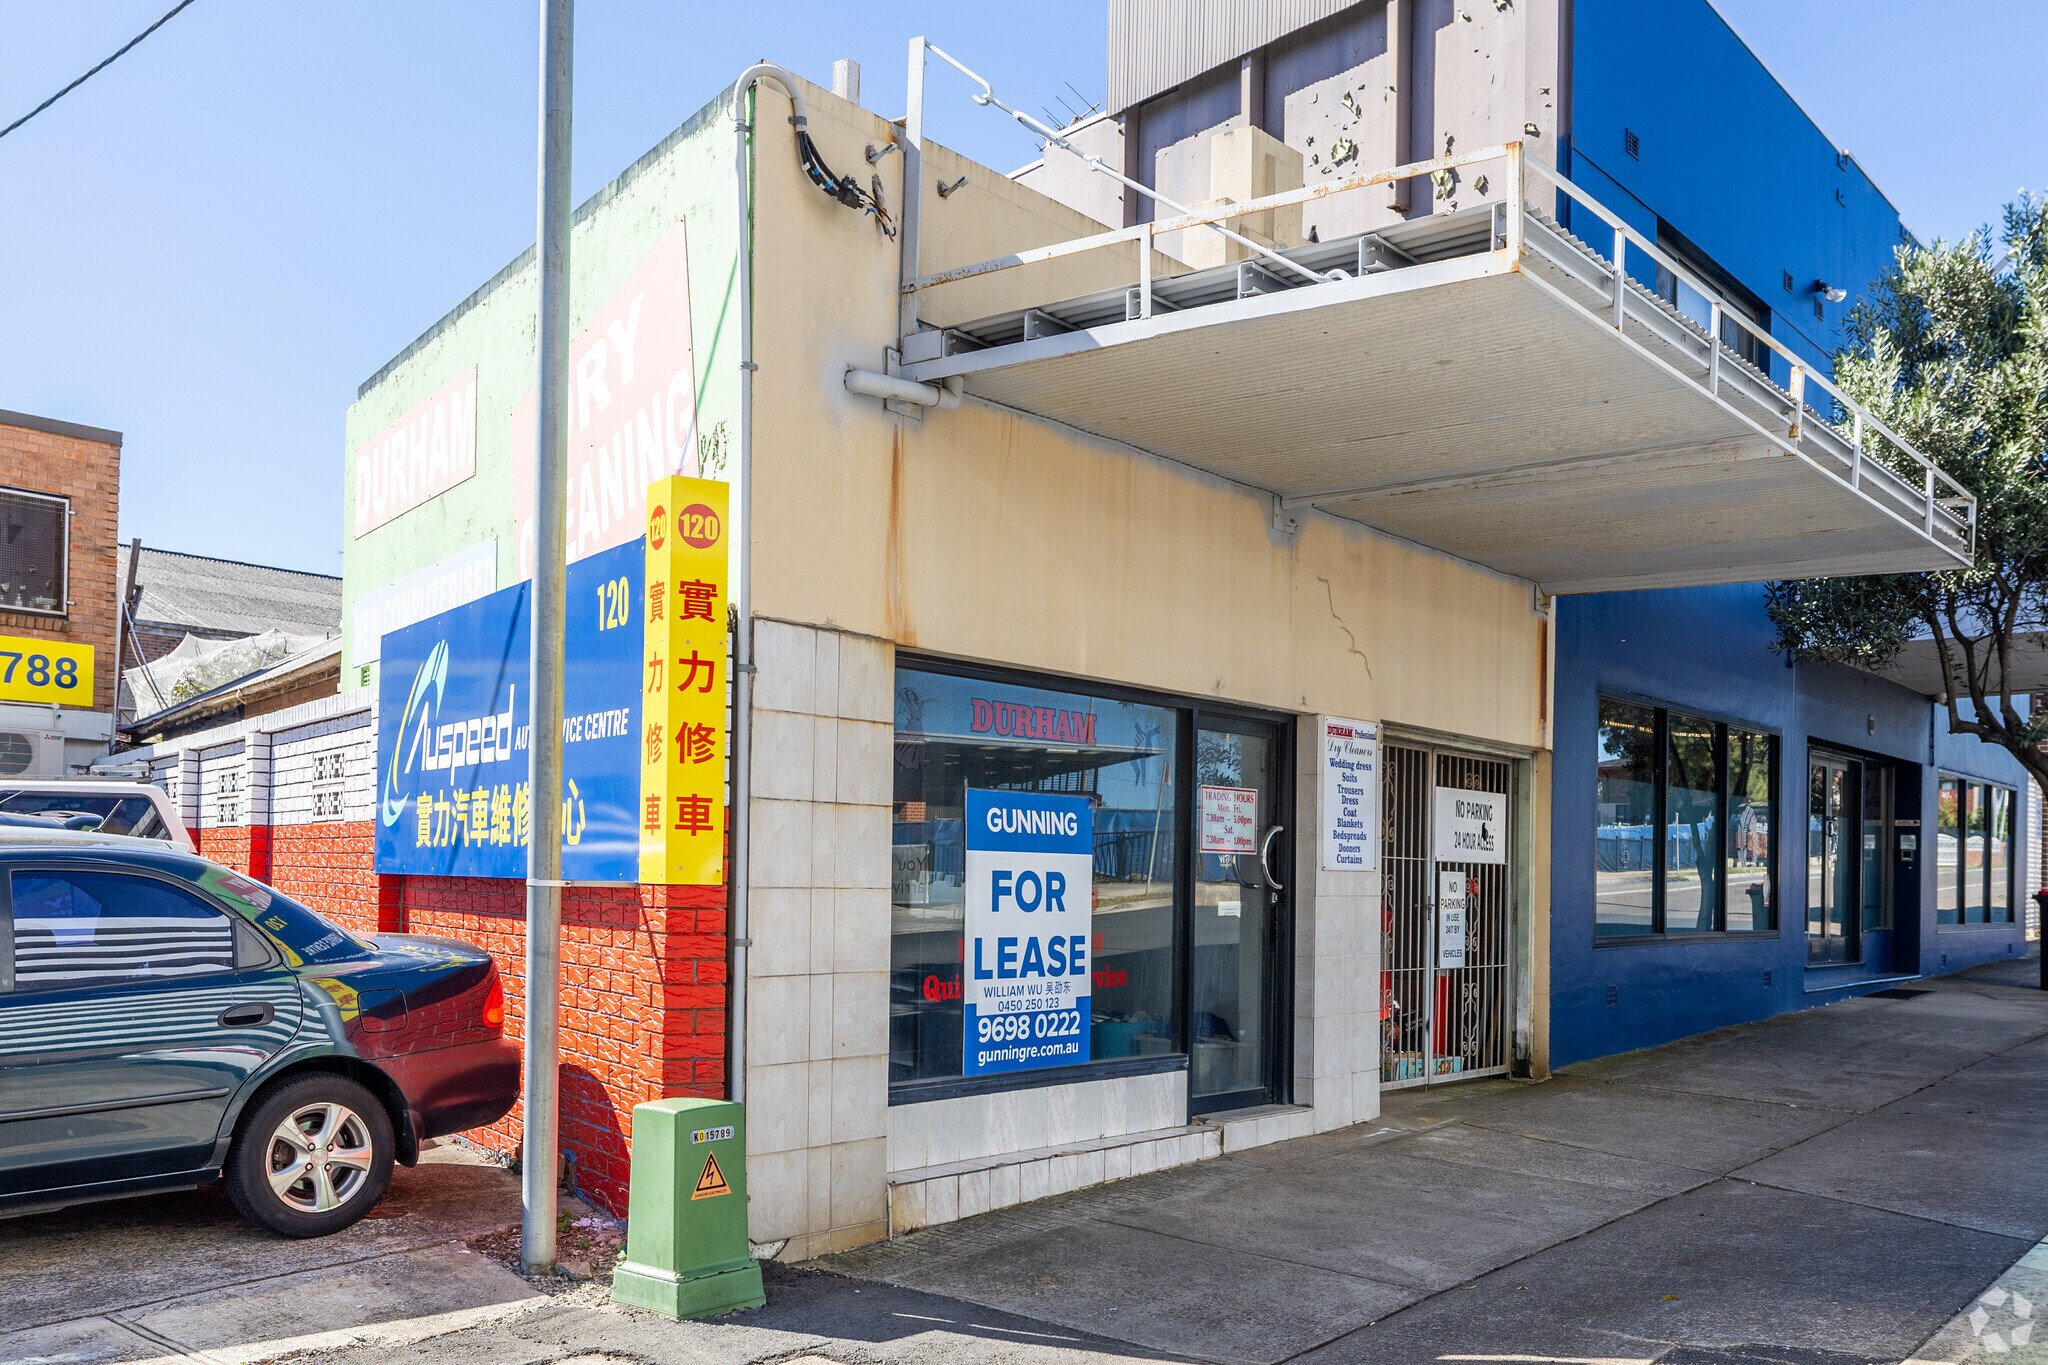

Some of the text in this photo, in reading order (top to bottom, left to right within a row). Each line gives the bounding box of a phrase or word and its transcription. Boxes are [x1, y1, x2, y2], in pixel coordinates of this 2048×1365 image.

[567, 289, 645, 430] RY
[355, 378, 477, 528] DURHAM
[651, 513, 665, 542] 120
[680, 513, 719, 541] 120
[597, 576, 630, 632] 120
[0, 651, 78, 689] 788
[584, 708, 630, 741] CENTRE
[971, 697, 1098, 746] DURHAM
[1327, 725, 1353, 738] DURHAM
[1328, 738, 1373, 758] Dry Cleaners
[1329, 757, 1372, 772] Wedding dress
[1341, 772, 1358, 783] Suits
[1205, 791, 1254, 803] TRADING HOURS
[1337, 784, 1364, 795] Trousers
[1341, 795, 1359, 805] Dress
[415, 778, 586, 848] 實力汽車維修心
[1206, 813, 1225, 823] 7.30am
[1343, 807, 1357, 817] Coat
[1456, 800, 1493, 821] NO PARKING
[986, 807, 1078, 837] GUNNING
[1337, 818, 1363, 828] Blankets
[1206, 835, 1225, 845] 7.30am
[1333, 830, 1367, 842] Bedspreads
[1455, 831, 1494, 852] 24 HOUR ACCESS
[1336, 854, 1363, 864] Curtains
[991, 870, 1067, 913] FOR
[1449, 881, 1458, 893] NO
[1441, 898, 1466, 910] PARKING
[1446, 913, 1460, 922] IN USE
[1454, 926, 1460, 934] BY
[974, 935, 1086, 980] LEASE
[1443, 949, 1463, 958] VEHICLES
[984, 984, 1025, 998] WILLIAM
[1027, 984, 1043, 996] WU
[998, 997, 1060, 1012] 0450 250 123
[978, 1010, 1081, 1043] 9698 0222
[978, 1041, 1079, 1067] gunningre.com.au
